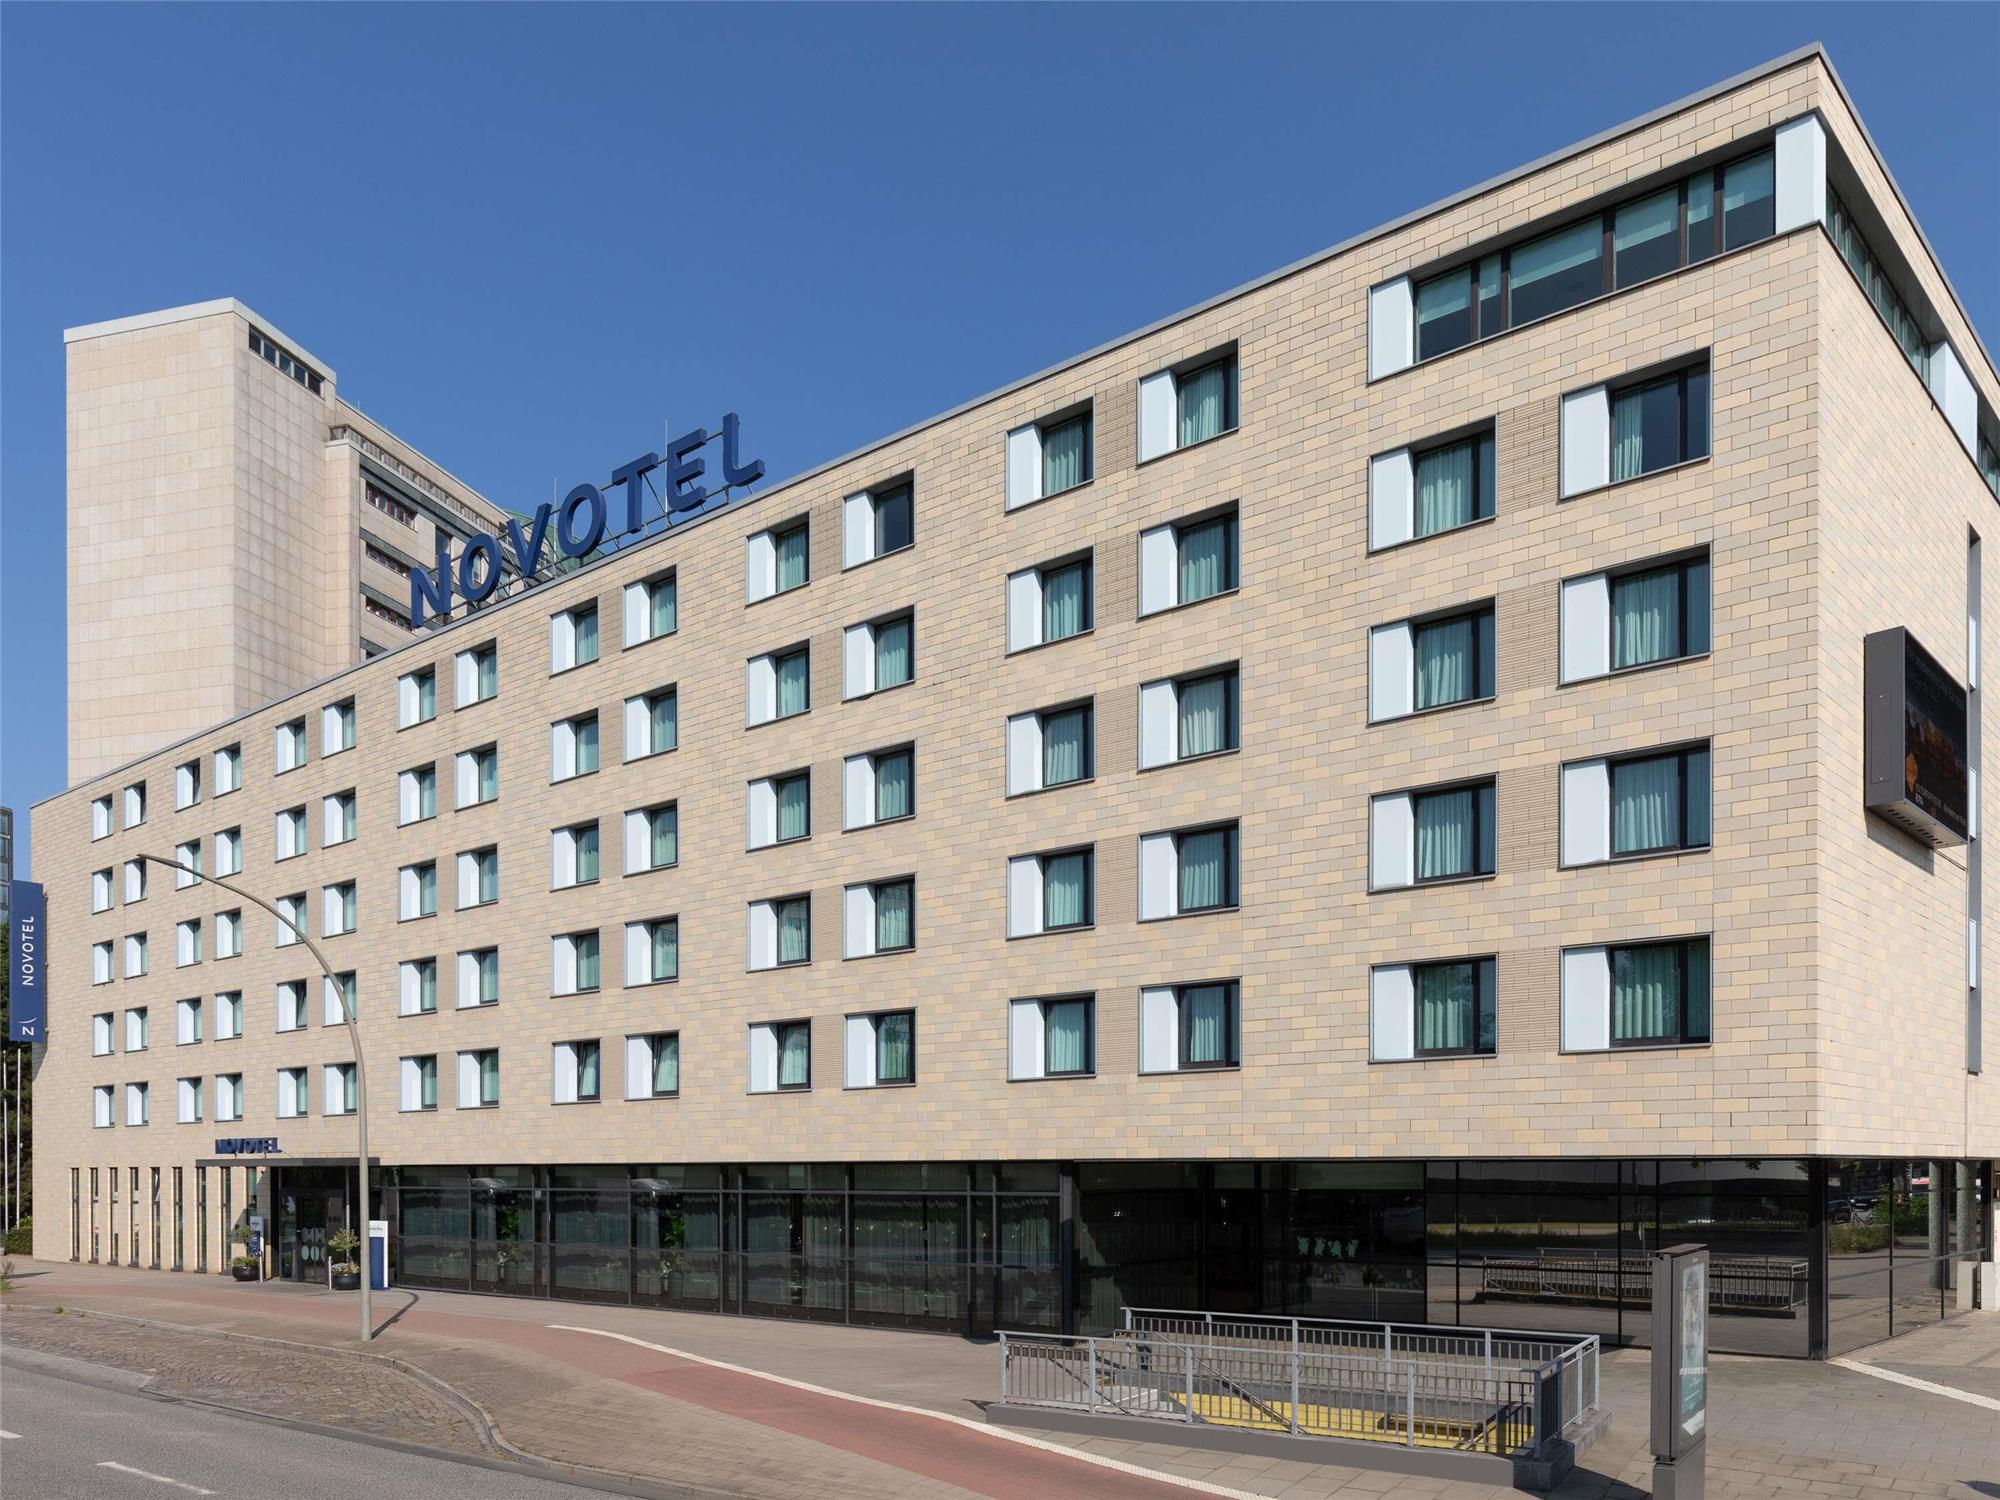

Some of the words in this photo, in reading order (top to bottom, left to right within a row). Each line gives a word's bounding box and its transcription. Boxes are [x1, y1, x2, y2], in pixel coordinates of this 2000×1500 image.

[410, 412, 766, 629] NOVOTEL
[22, 916, 34, 986] NOVOTEL
[215, 1137, 282, 1154] NOVOTEL
